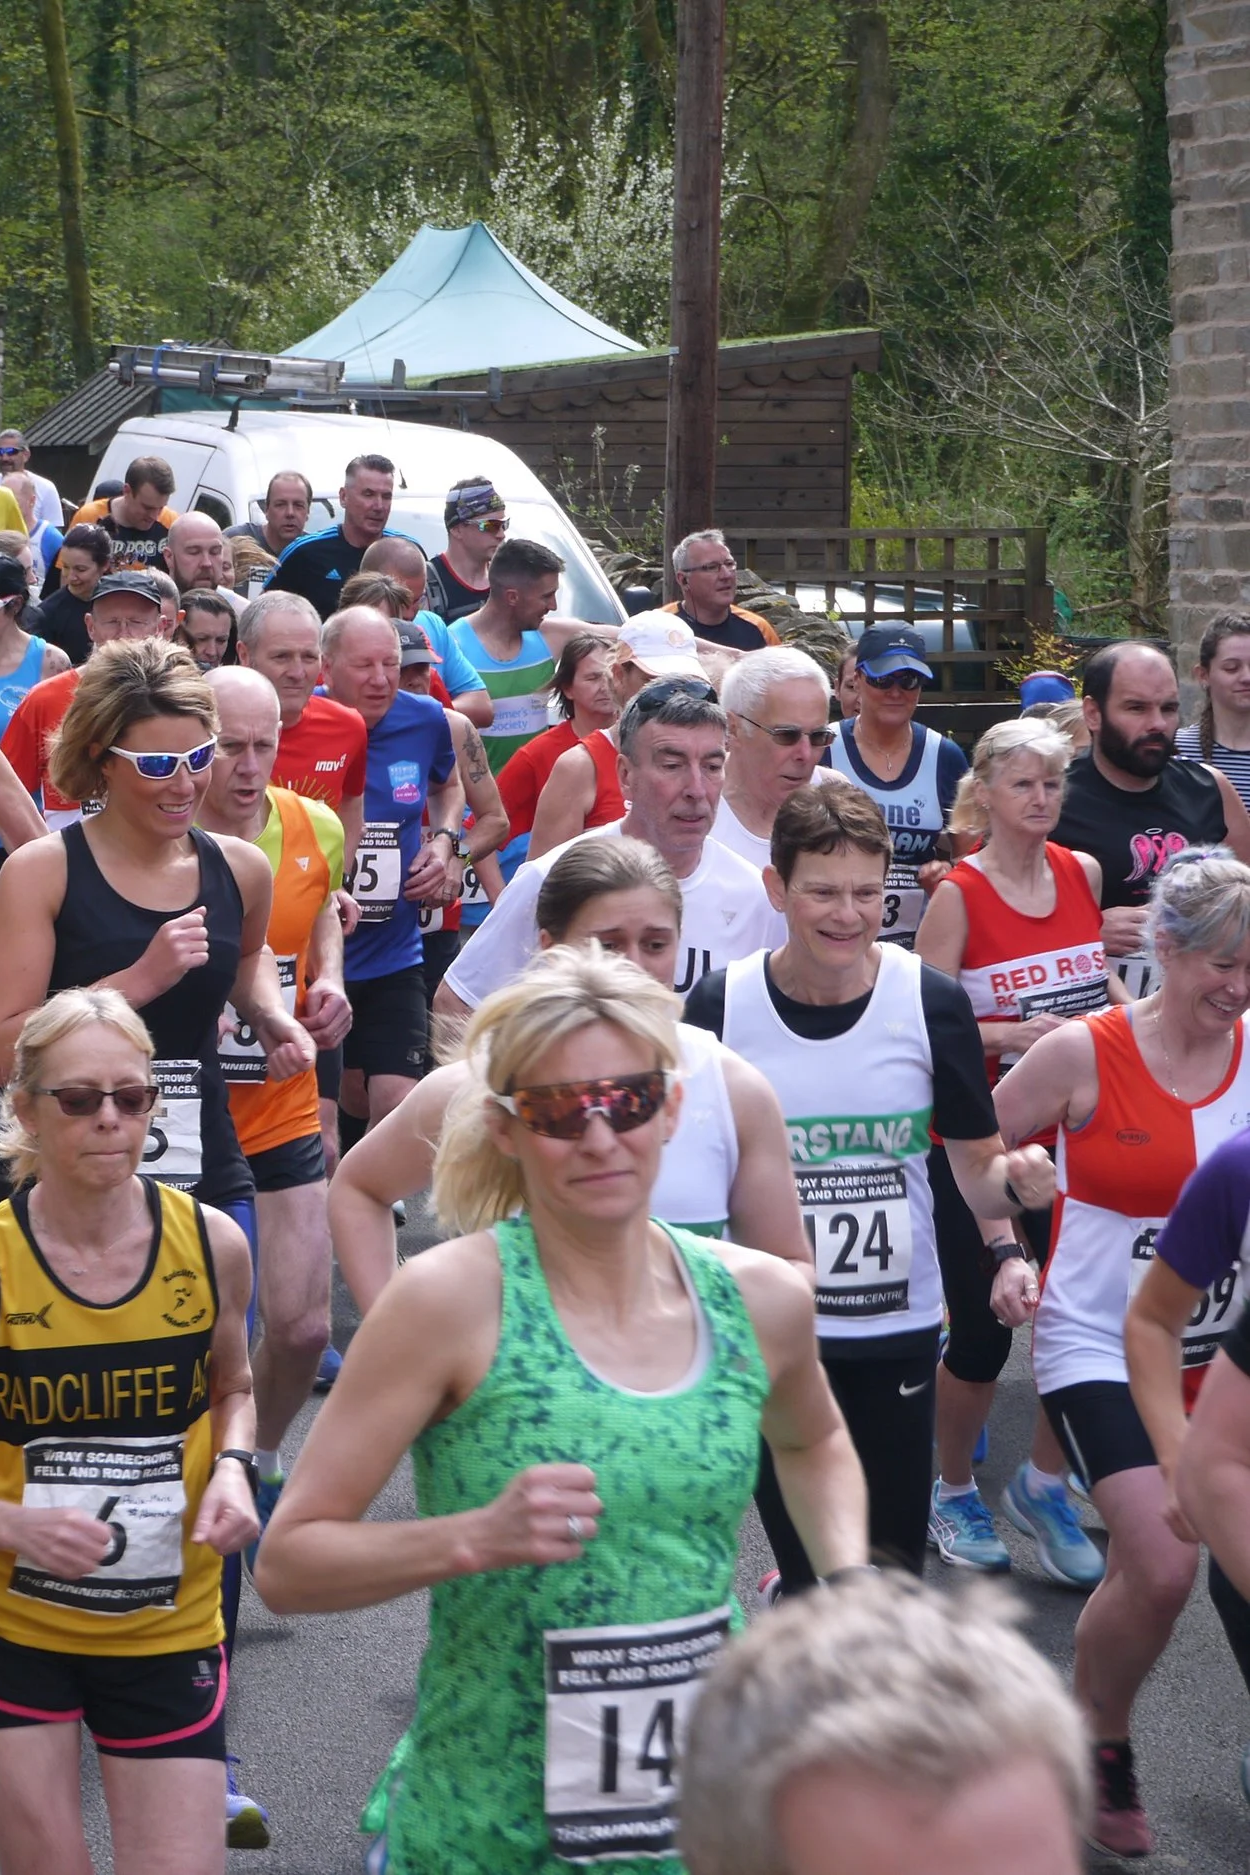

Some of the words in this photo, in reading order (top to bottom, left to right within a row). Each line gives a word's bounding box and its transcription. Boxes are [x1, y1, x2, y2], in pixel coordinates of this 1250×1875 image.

[127, 541, 156, 555] DOG
[990, 964, 1047, 993] RED
[164, 1085, 198, 1094] RACES
[787, 1117, 913, 1161] RSTANG
[795, 1178, 818, 1188] RAY
[820, 1172, 897, 1187] SCARECROWS
[806, 1189, 833, 1200] AND
[835, 1187, 866, 1199] ROAD
[868, 1183, 903, 1197] RACES
[814, 1290, 904, 1306] NNERSCENTRE
[43, 1450, 84, 1463] WRAY
[34, 1466, 65, 1477] FELL
[68, 1467, 99, 1478] AND
[102, 1468, 140, 1480] ROAD
